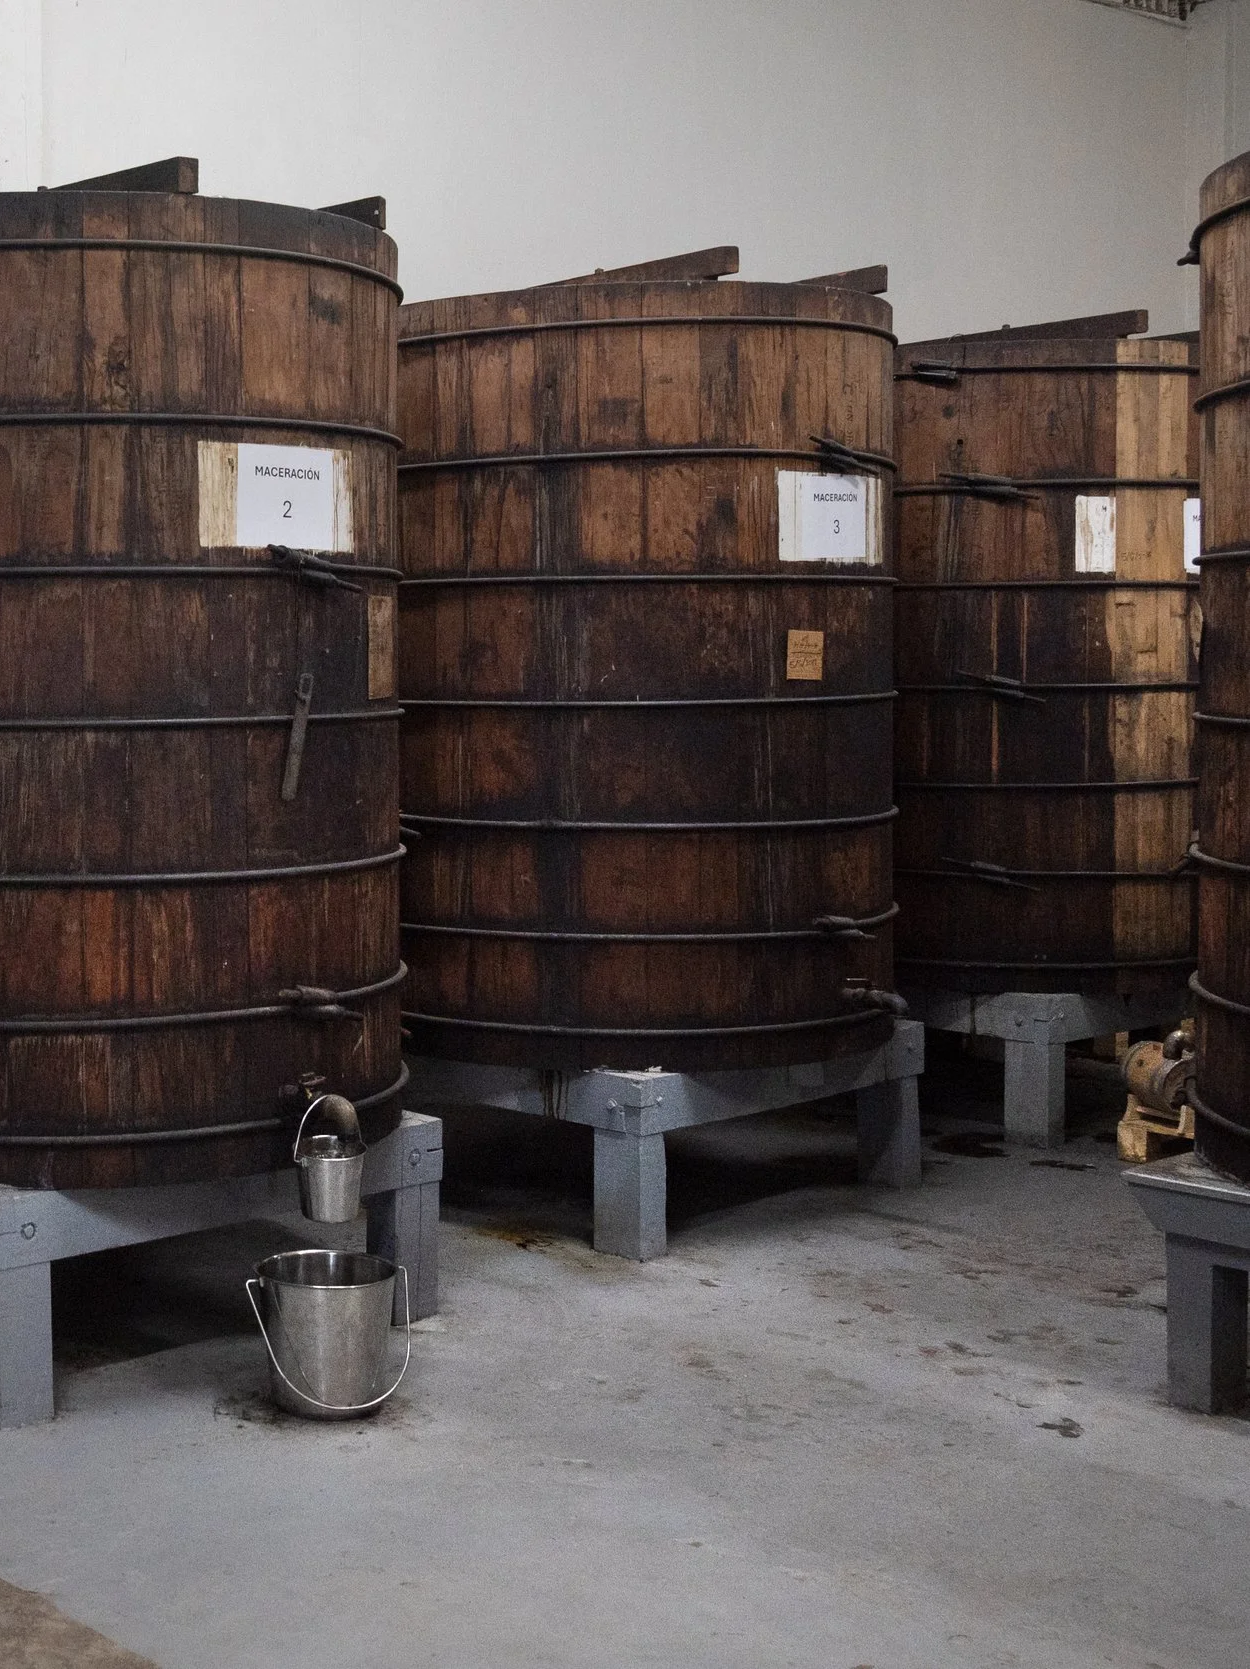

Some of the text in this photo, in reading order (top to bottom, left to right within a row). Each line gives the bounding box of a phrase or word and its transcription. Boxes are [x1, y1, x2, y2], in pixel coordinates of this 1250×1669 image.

[254, 465, 321, 481] MACERACIÓN
[813, 491, 858, 502] MACERACIÓN
[282, 500, 293, 519] 2
[833, 519, 841, 534] 3
